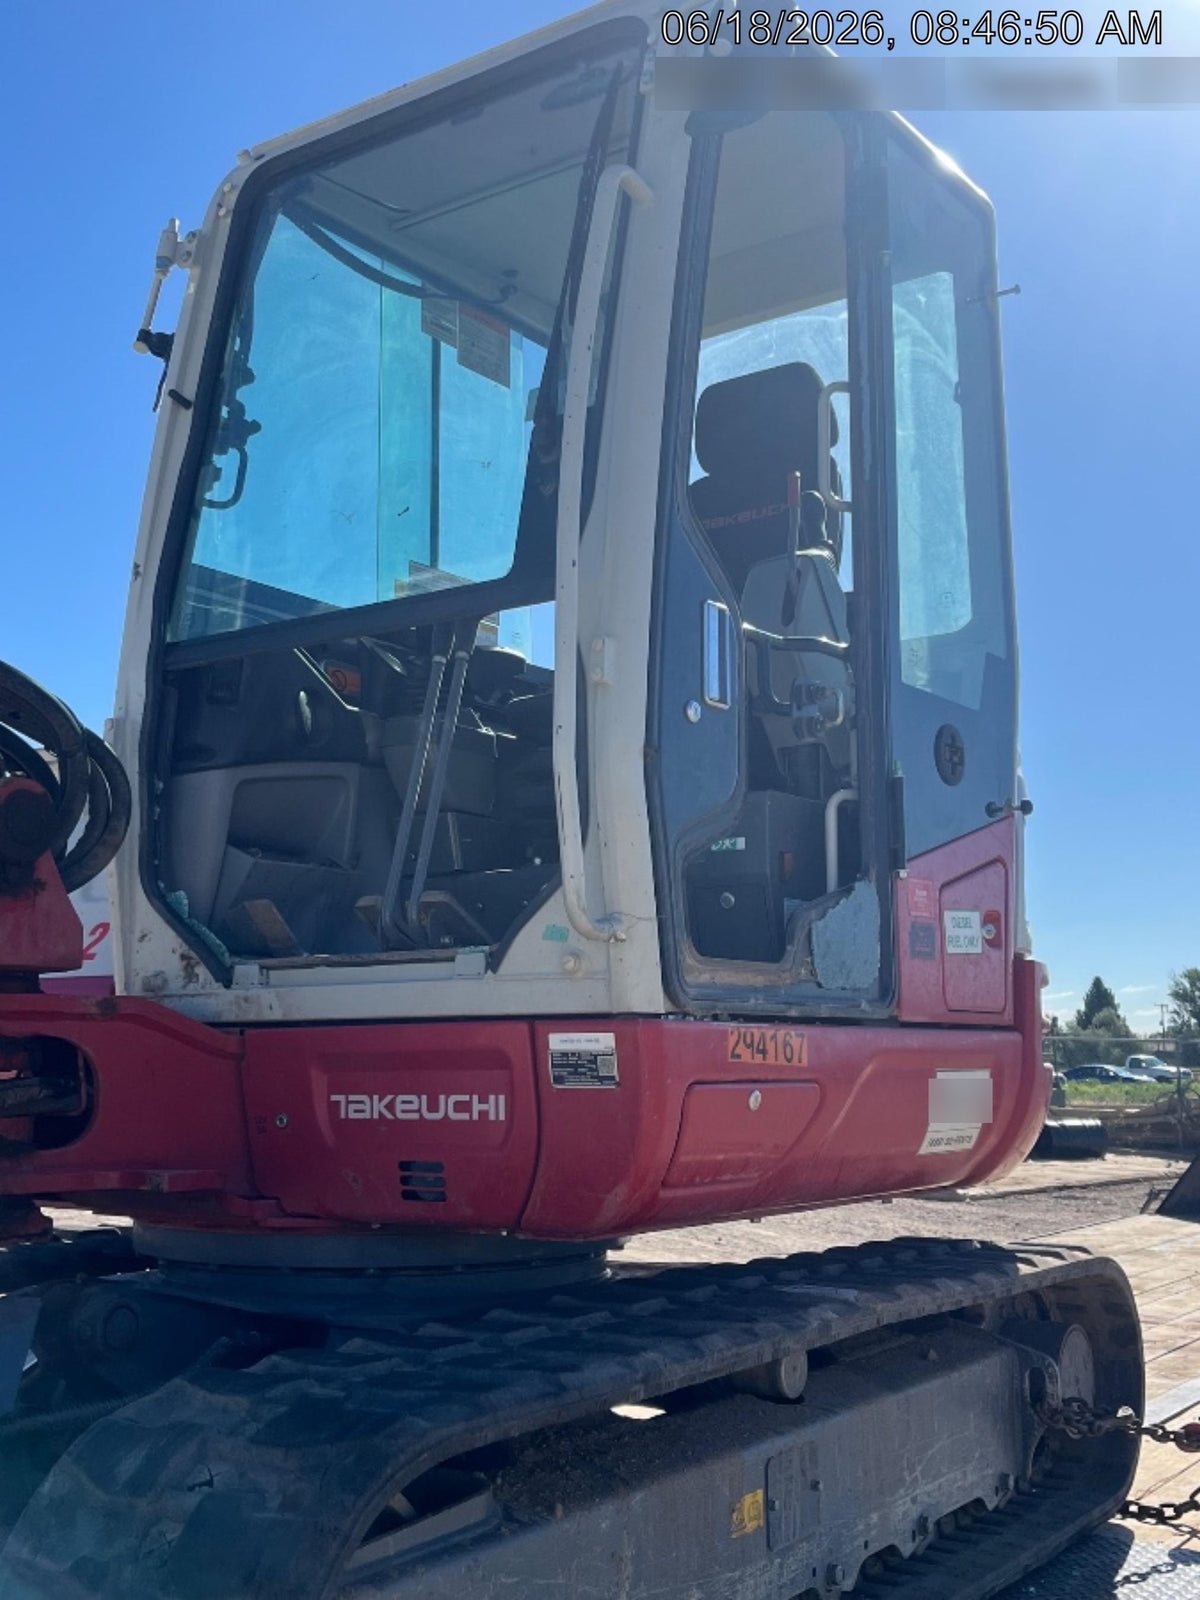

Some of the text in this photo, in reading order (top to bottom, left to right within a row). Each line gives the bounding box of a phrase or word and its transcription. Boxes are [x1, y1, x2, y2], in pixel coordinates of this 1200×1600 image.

[702, 502, 790, 529] TAKEUCH
[730, 1029, 806, 1064] 294167
[330, 1094, 506, 1121] TAKEUCHI
